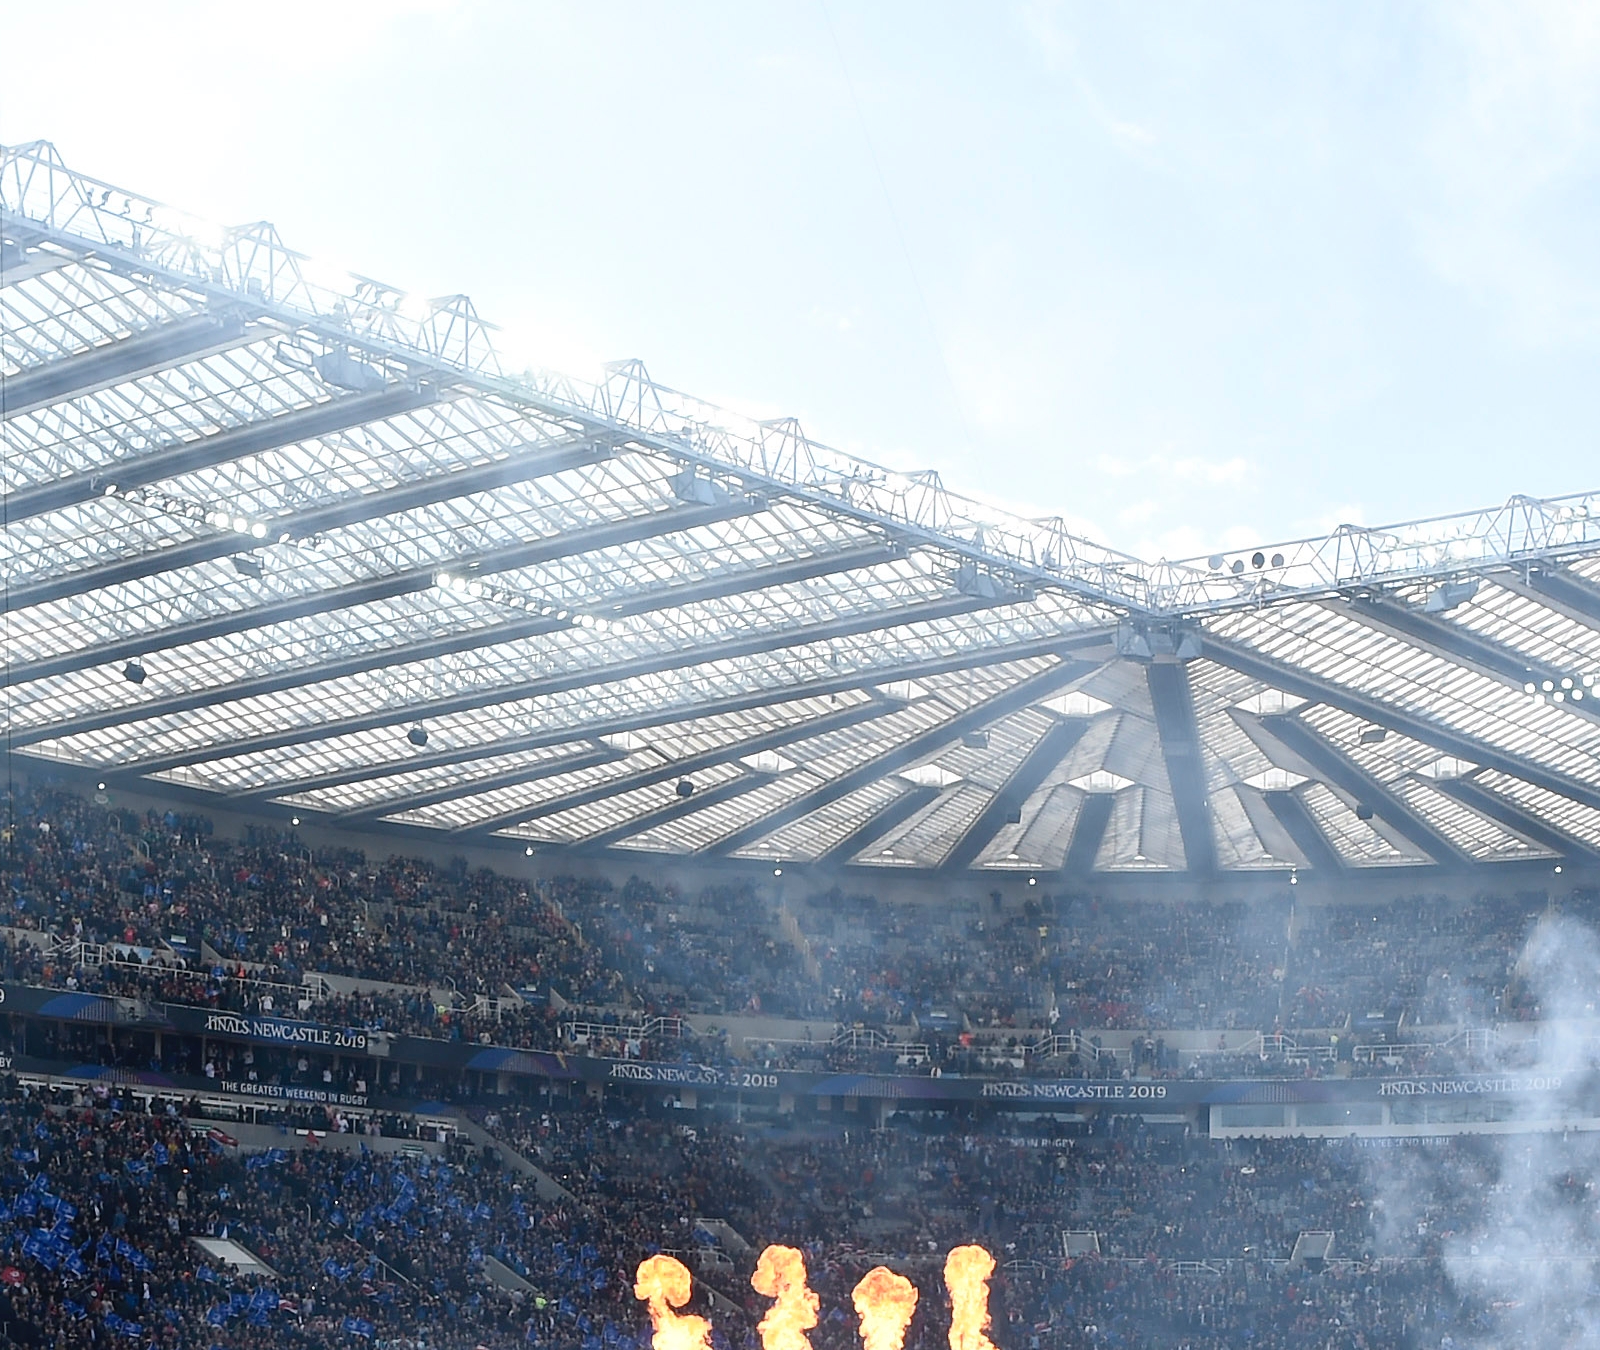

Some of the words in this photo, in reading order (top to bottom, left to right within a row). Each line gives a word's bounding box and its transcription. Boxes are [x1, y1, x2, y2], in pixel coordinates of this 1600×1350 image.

[205, 1015, 250, 1034] FINALS
[252, 1021, 331, 1044] NEWCASTLE
[334, 1031, 366, 1049] 2019
[742, 1073, 779, 1088] 2019
[1432, 1078, 1519, 1095] NEWCASTLE
[221, 1081, 238, 1094] THE
[240, 1083, 283, 1098] GREATEST
[286, 1087, 326, 1102] WEEKEND
[340, 1093, 368, 1106] RUGBY
[1033, 1084, 1124, 1099] NEWCASTLE
[1128, 1085, 1167, 1099] 2019
